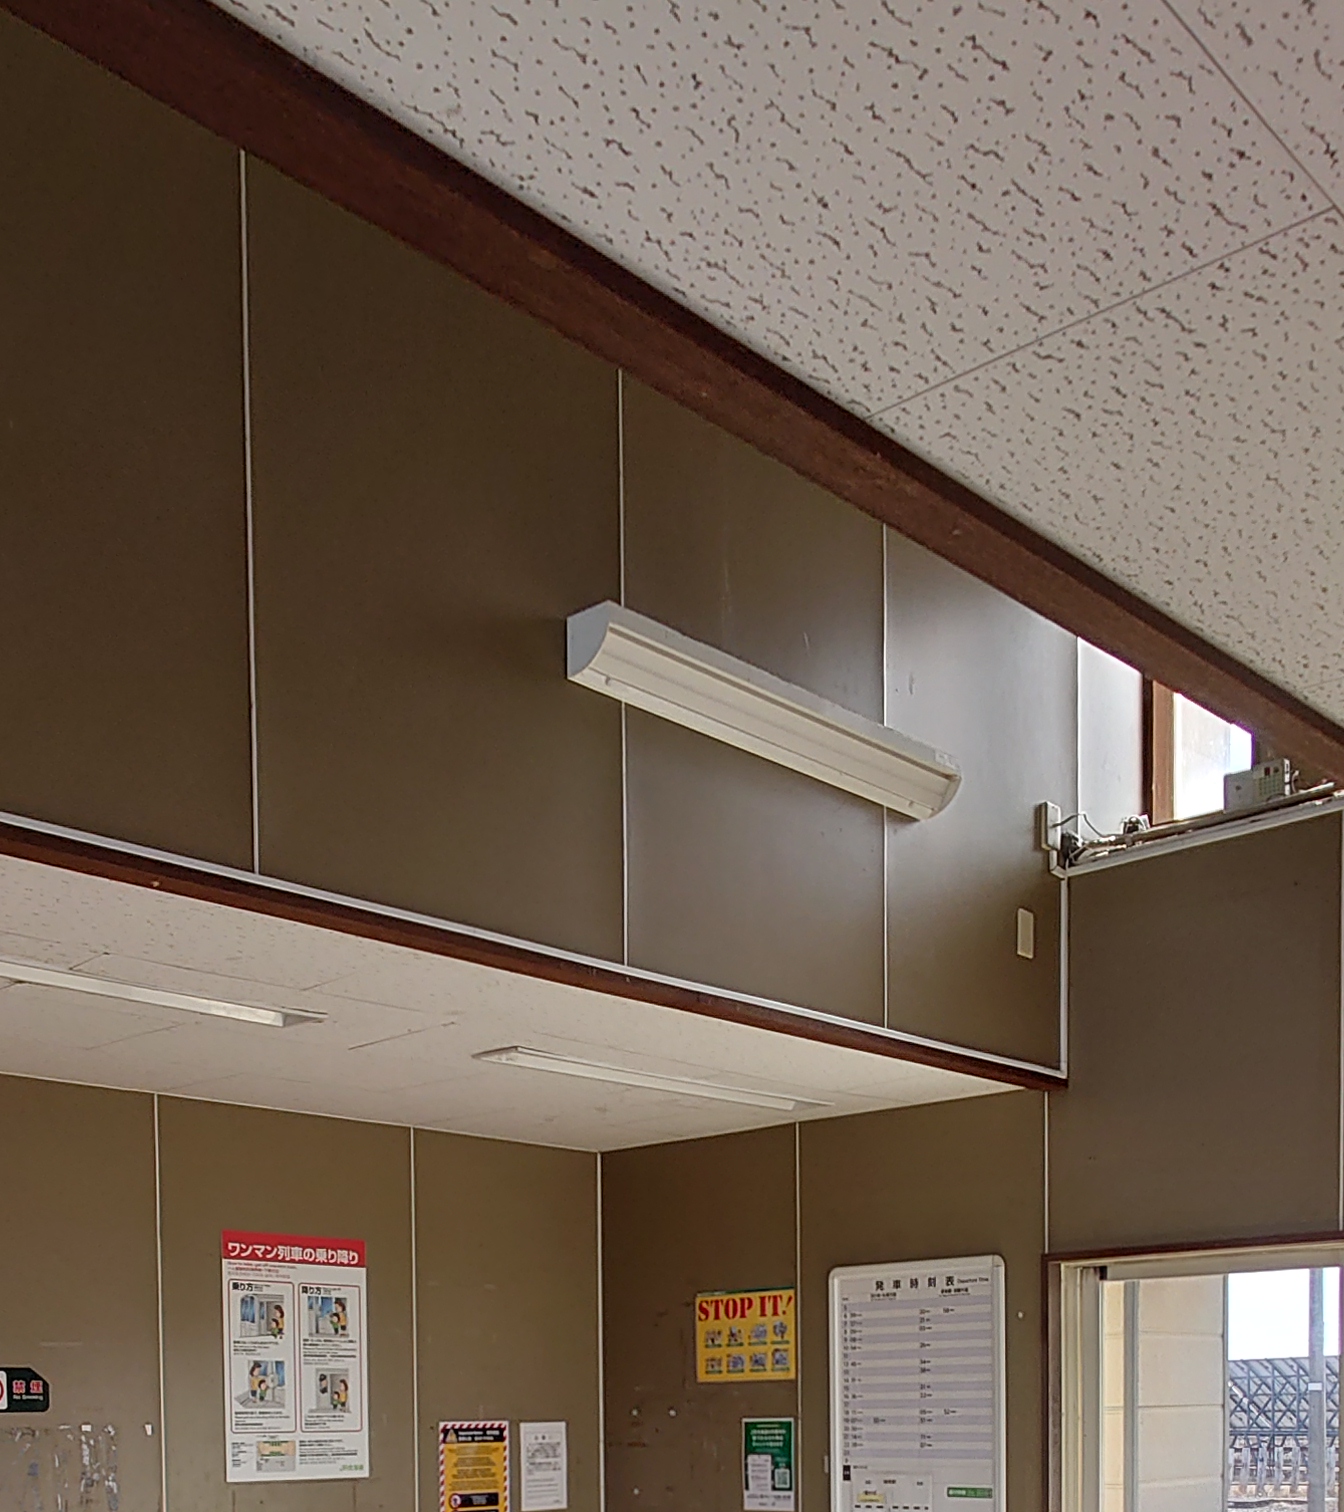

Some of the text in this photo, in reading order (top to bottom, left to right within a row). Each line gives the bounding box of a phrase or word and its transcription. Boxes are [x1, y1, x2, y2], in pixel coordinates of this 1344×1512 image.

[228, 1242, 359, 1265] ワンマン列車の乗り降り
[875, 1275, 955, 1291] 発車時刻表
[698, 1294, 793, 1321] STOP IT!
[12, 1380, 44, 1394] 禁煙
